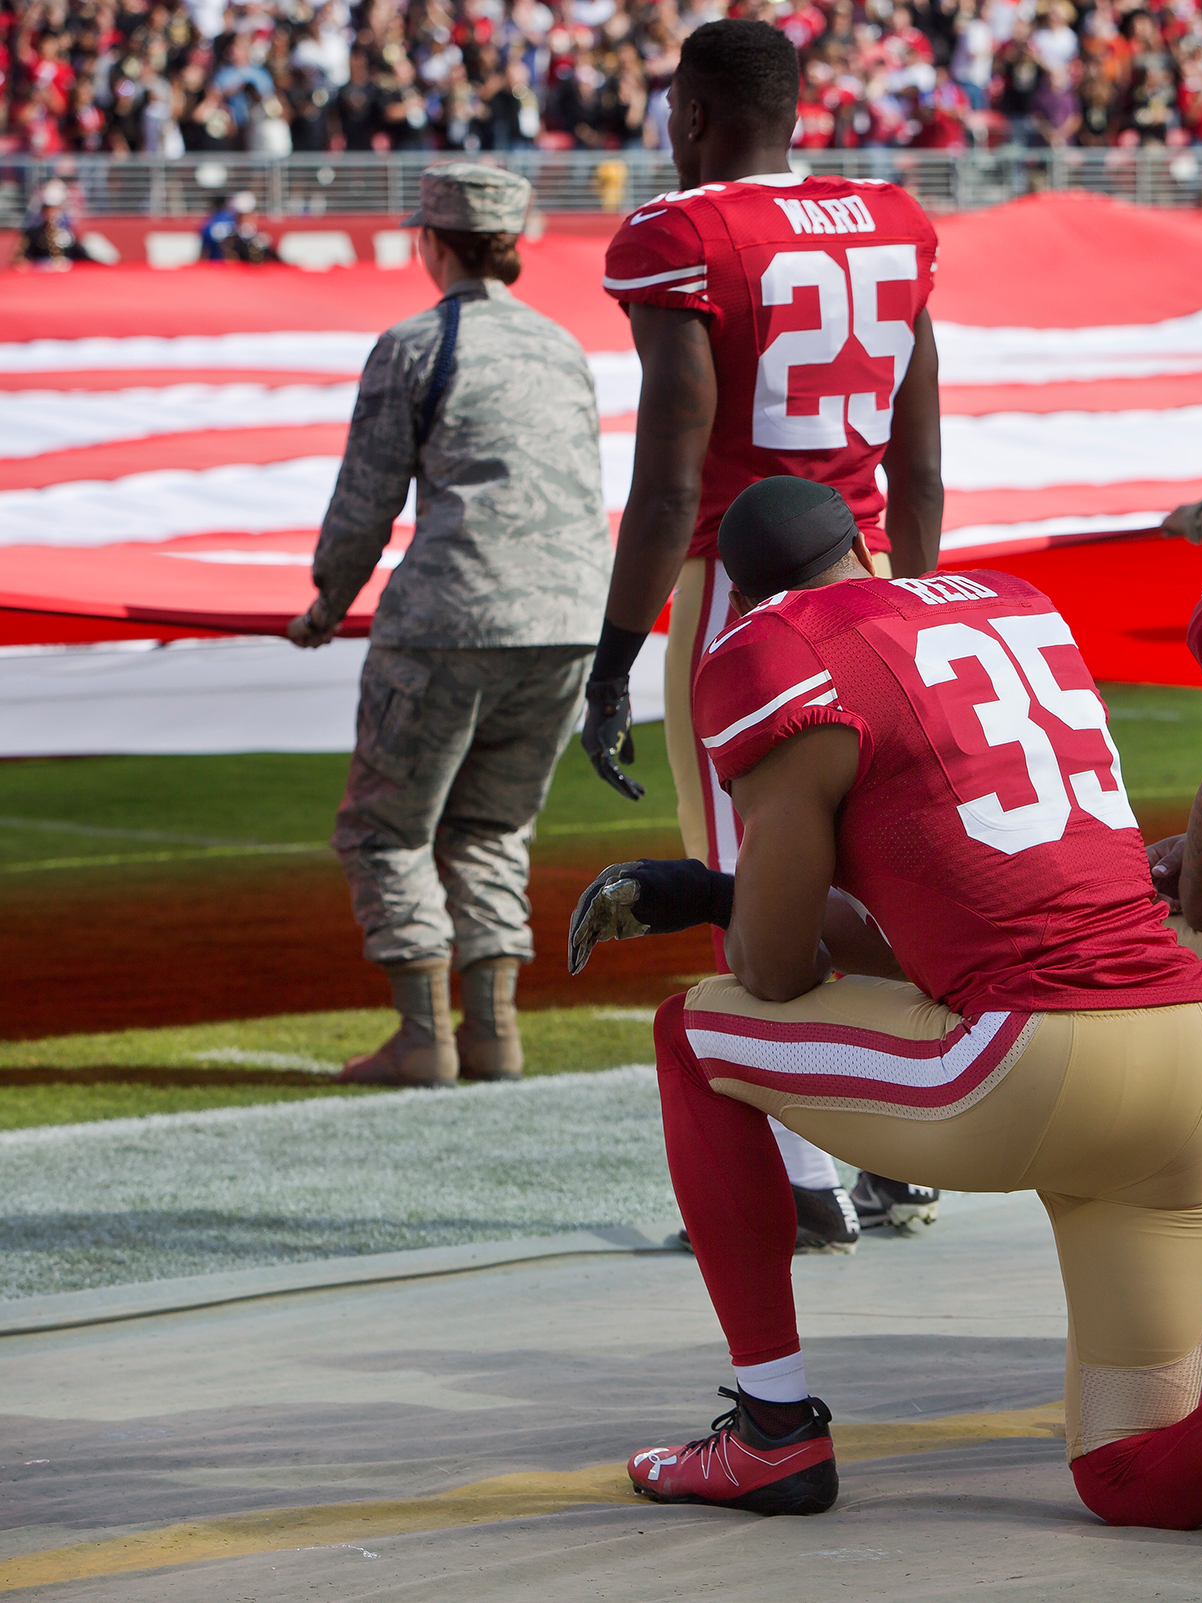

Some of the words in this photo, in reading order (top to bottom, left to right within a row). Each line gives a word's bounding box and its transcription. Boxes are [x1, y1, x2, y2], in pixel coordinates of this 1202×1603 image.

[773, 195, 876, 234] WARD
[752, 244, 918, 450] 25
[888, 575, 999, 605] REID
[914, 611, 1140, 856] 35
[832, 1188, 861, 1234] NIKE
